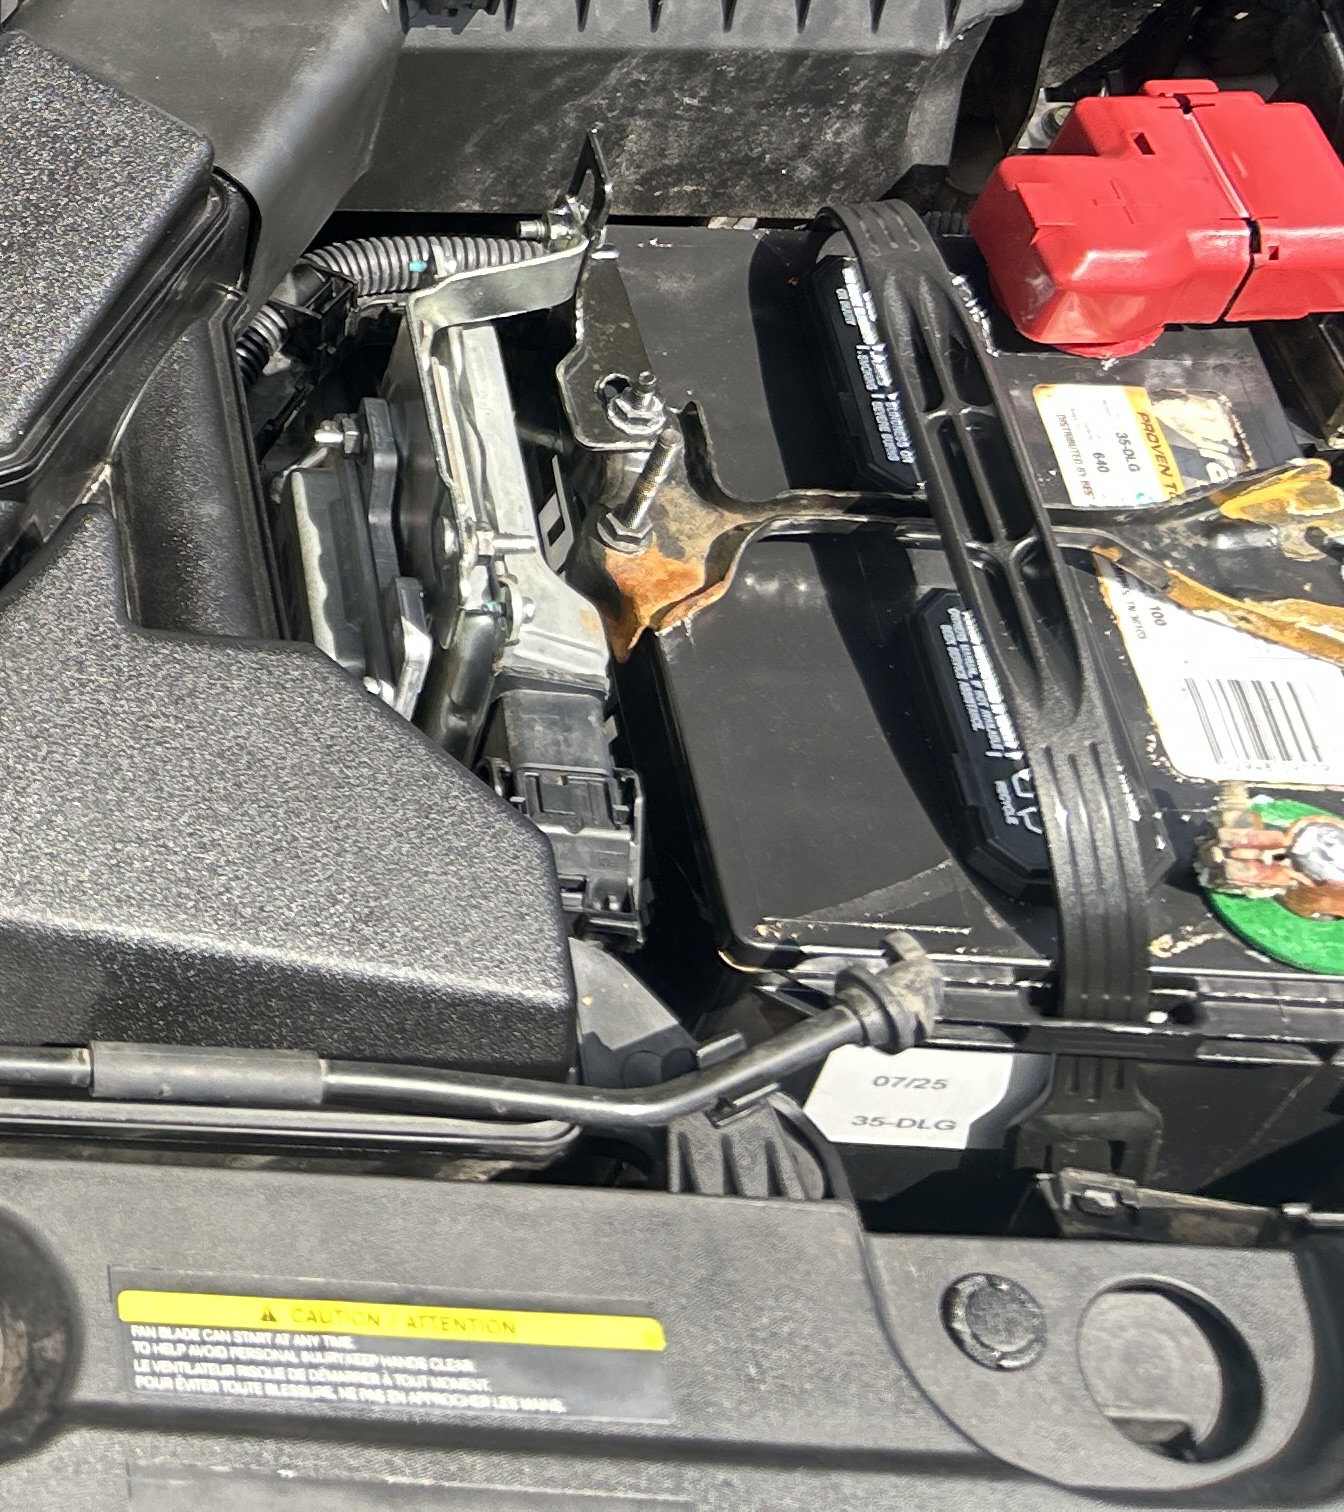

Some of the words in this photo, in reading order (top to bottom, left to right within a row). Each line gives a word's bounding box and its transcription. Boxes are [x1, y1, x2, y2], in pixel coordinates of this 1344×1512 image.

[1056, 413, 1083, 465] DISTRIBUTED
[1076, 466, 1088, 478] BY
[1115, 431, 1141, 473] 35-DLG
[1136, 410, 1172, 478] PROVEN
[1092, 451, 1111, 474] 640
[1149, 605, 1168, 628] 100
[872, 1075, 949, 1091] 07/25
[850, 1113, 958, 1131] 35-DLG
[291, 1307, 380, 1327] CAUTION
[407, 1315, 516, 1334] ATTENTION
[130, 1324, 156, 1338] FAN
[159, 1326, 200, 1340] BLADE
[202, 1328, 230, 1342] CAN
[233, 1330, 272, 1344] START
[274, 1332, 291, 1345] AT
[293, 1333, 322, 1347] ANY
[132, 1340, 152, 1354] TO
[153, 1342, 186, 1356] HELP
[188, 1344, 227, 1358] AVOID
[230, 1346, 298, 1363] PERSONAL
[134, 1358, 151, 1373] LE
[153, 1360, 234, 1377] VENTILATEUR
[288, 1368, 306, 1382] DE
[135, 1374, 174, 1390] POUR
